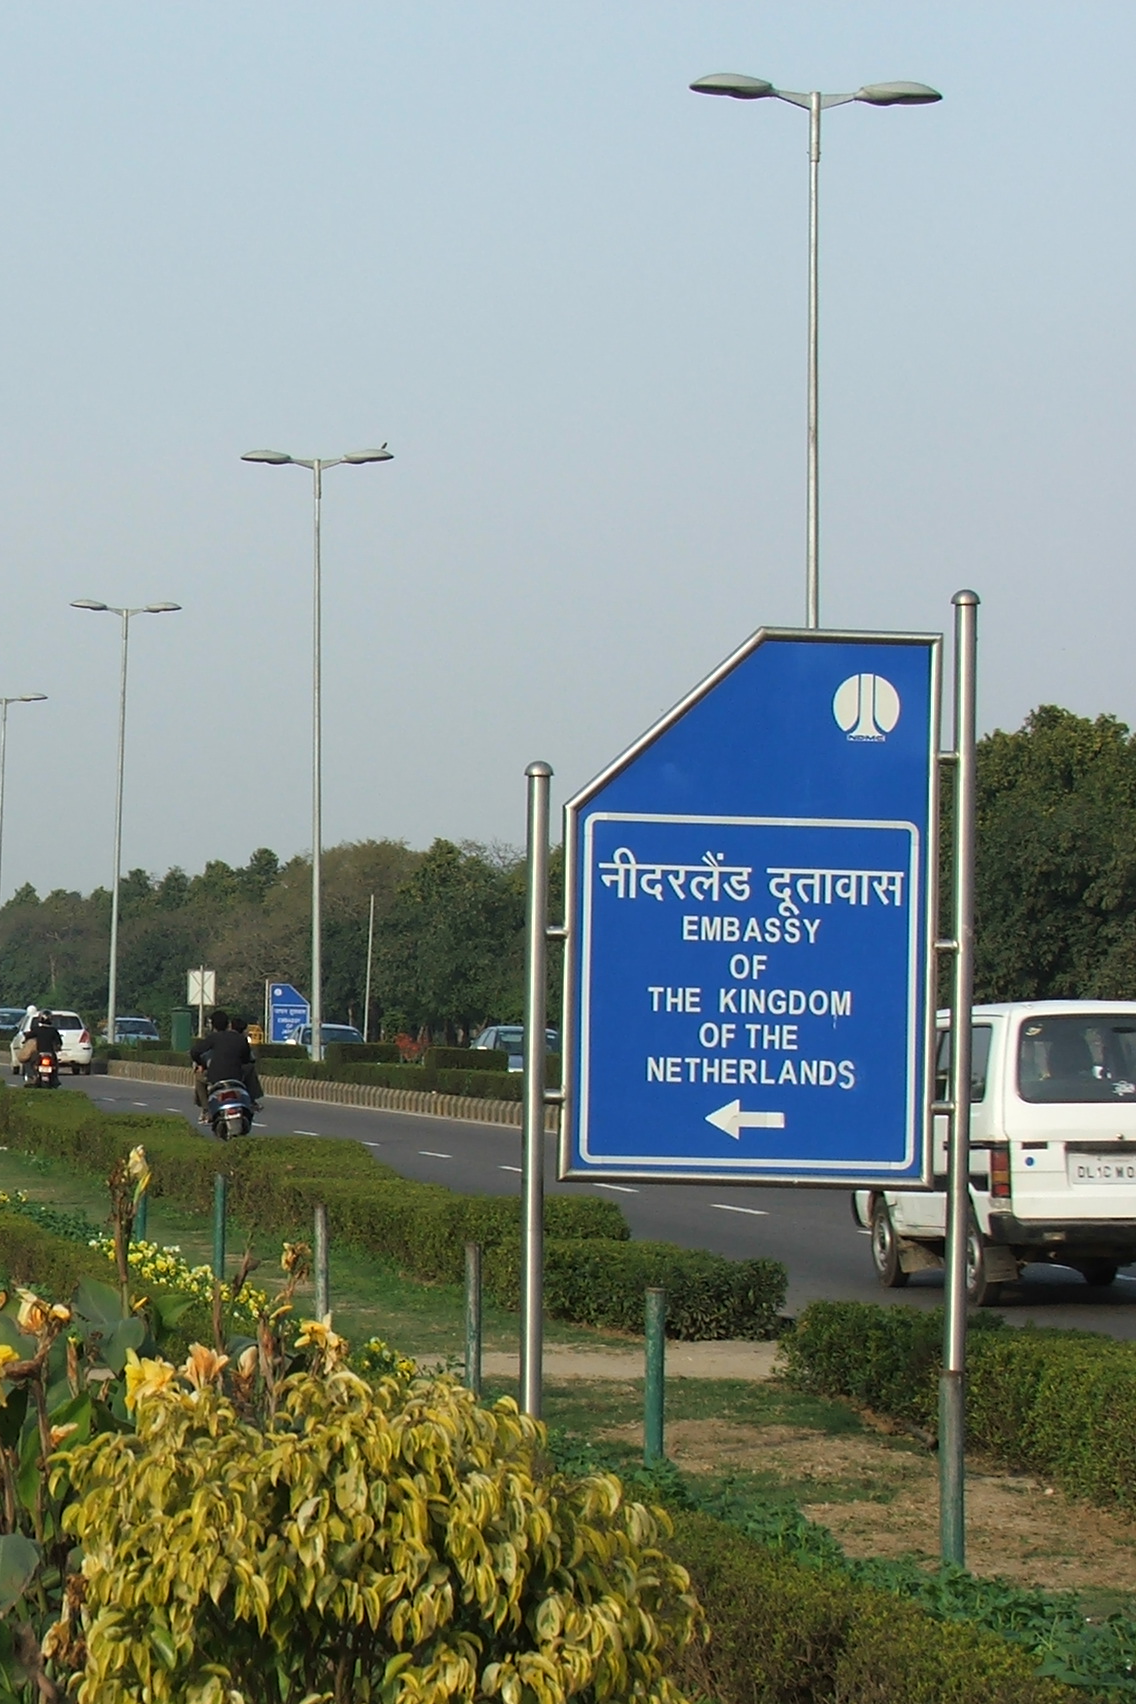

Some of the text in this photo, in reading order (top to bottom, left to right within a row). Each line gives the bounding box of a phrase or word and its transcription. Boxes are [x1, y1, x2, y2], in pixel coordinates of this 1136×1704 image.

[599, 847, 904, 915] नीदरलैंड दूतावास
[682, 916, 820, 944] EMBASSY
[729, 954, 767, 980] OF
[648, 987, 851, 1016] THE KINGDOM
[699, 1022, 798, 1050] OF THE
[647, 1057, 855, 1090] NETHERLANDS
